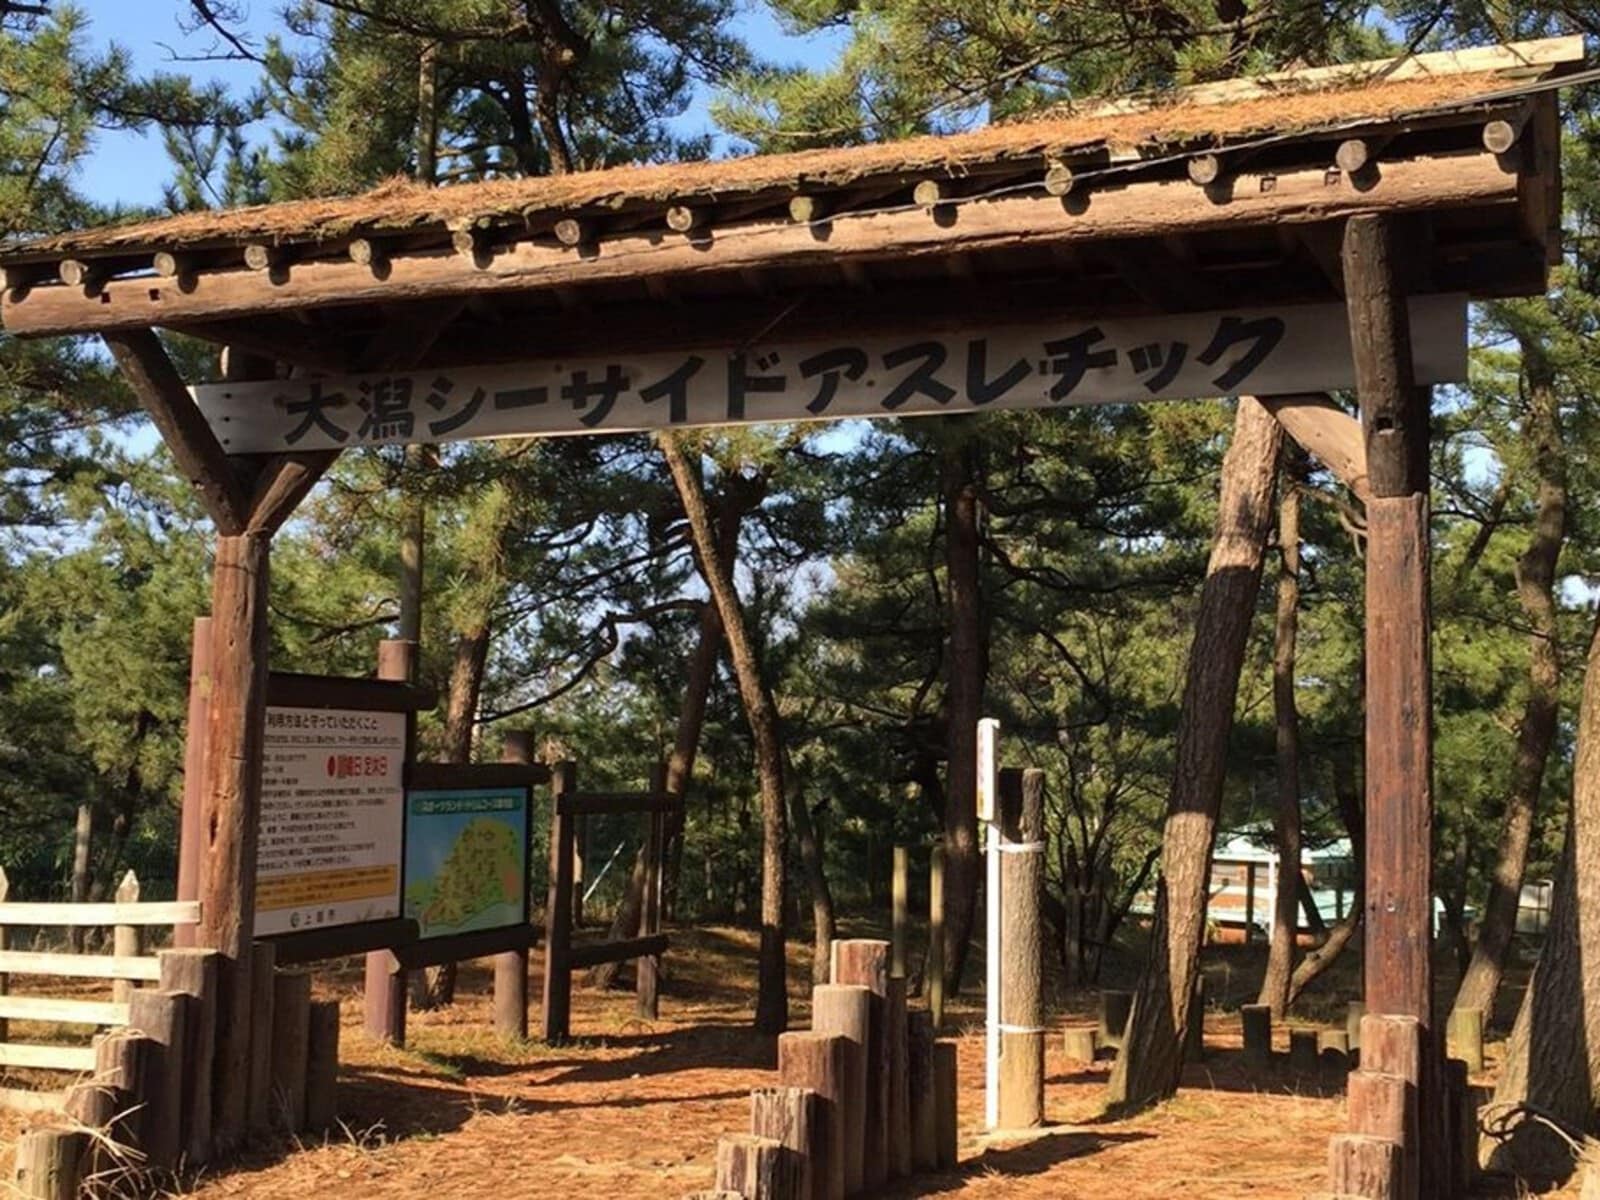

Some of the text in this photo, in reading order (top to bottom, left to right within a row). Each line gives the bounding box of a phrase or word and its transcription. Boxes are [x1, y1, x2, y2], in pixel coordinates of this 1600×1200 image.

[285, 316, 1286, 446] 大潟シーサイドアスレチック
